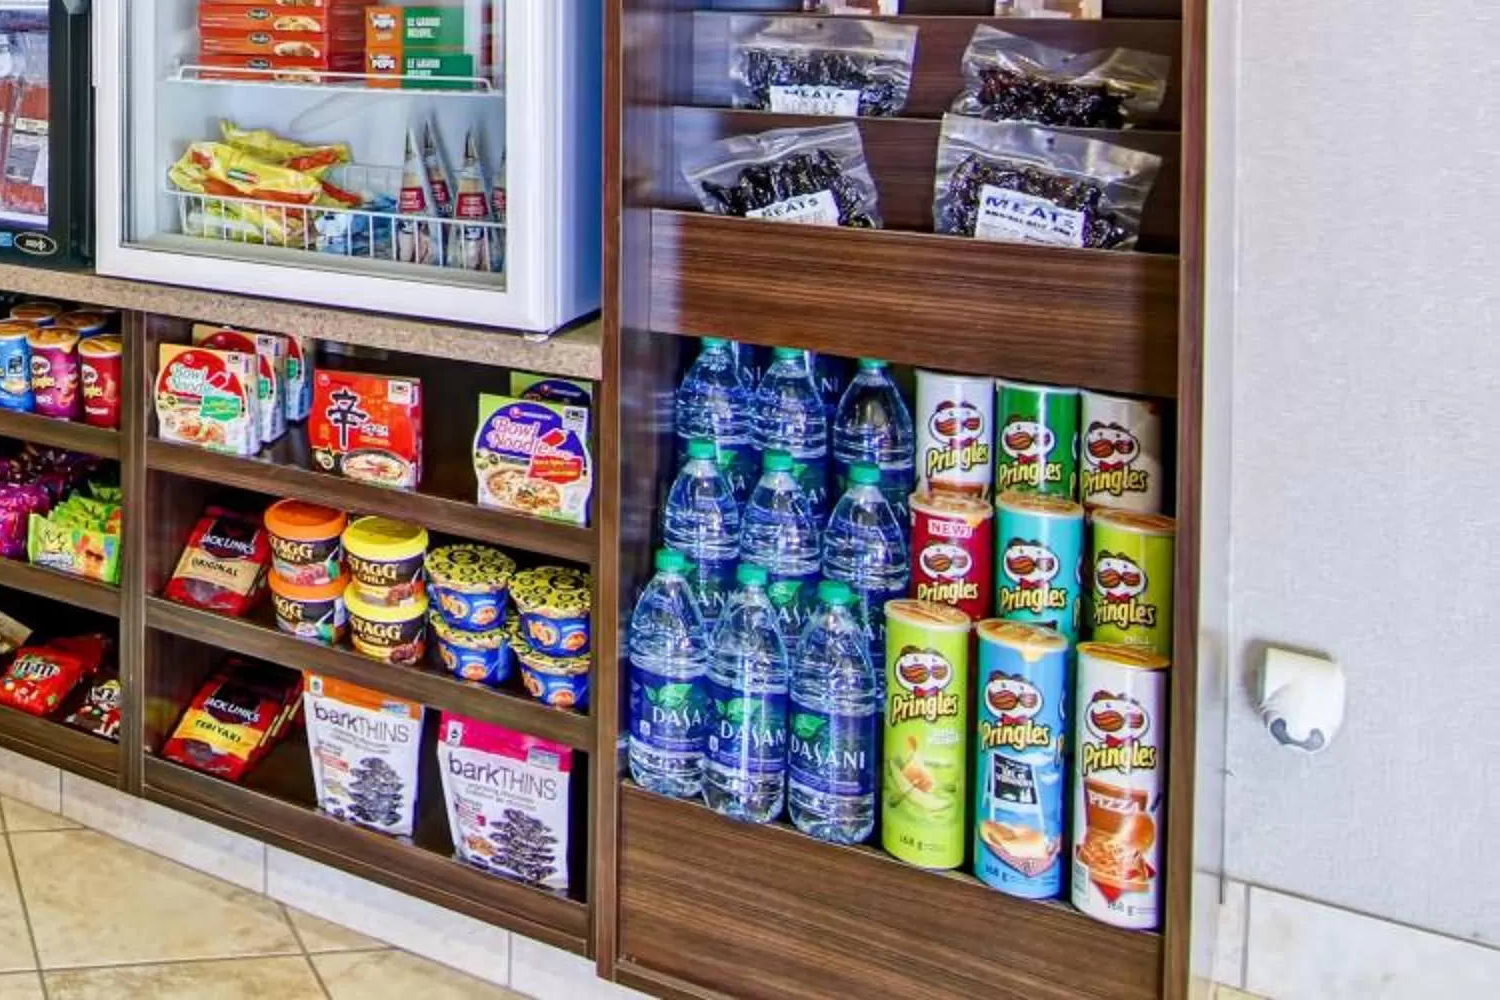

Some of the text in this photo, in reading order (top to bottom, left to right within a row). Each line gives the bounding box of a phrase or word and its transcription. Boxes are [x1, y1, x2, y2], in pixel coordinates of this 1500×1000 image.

[984, 194, 1077, 230] MEATS
[326, 388, 367, 449] 辛
[491, 416, 540, 438] Bowl
[486, 431, 550, 454] Noodle
[927, 441, 989, 476] Pringles
[1082, 467, 1148, 495] Pringles
[191, 557, 238, 577] ORIGINAL
[917, 578, 978, 605] Pringles
[1000, 584, 1066, 611] Pringles
[314, 701, 410, 744] barkTHINS
[890, 692, 959, 726] Pringles
[194, 719, 242, 743] TERIYAKI
[719, 719, 786, 748] DASAN
[980, 721, 1050, 751] Pringles
[791, 734, 866, 770] DASANI
[1083, 744, 1156, 775] Pringles
[449, 751, 558, 801] barkTHINS
